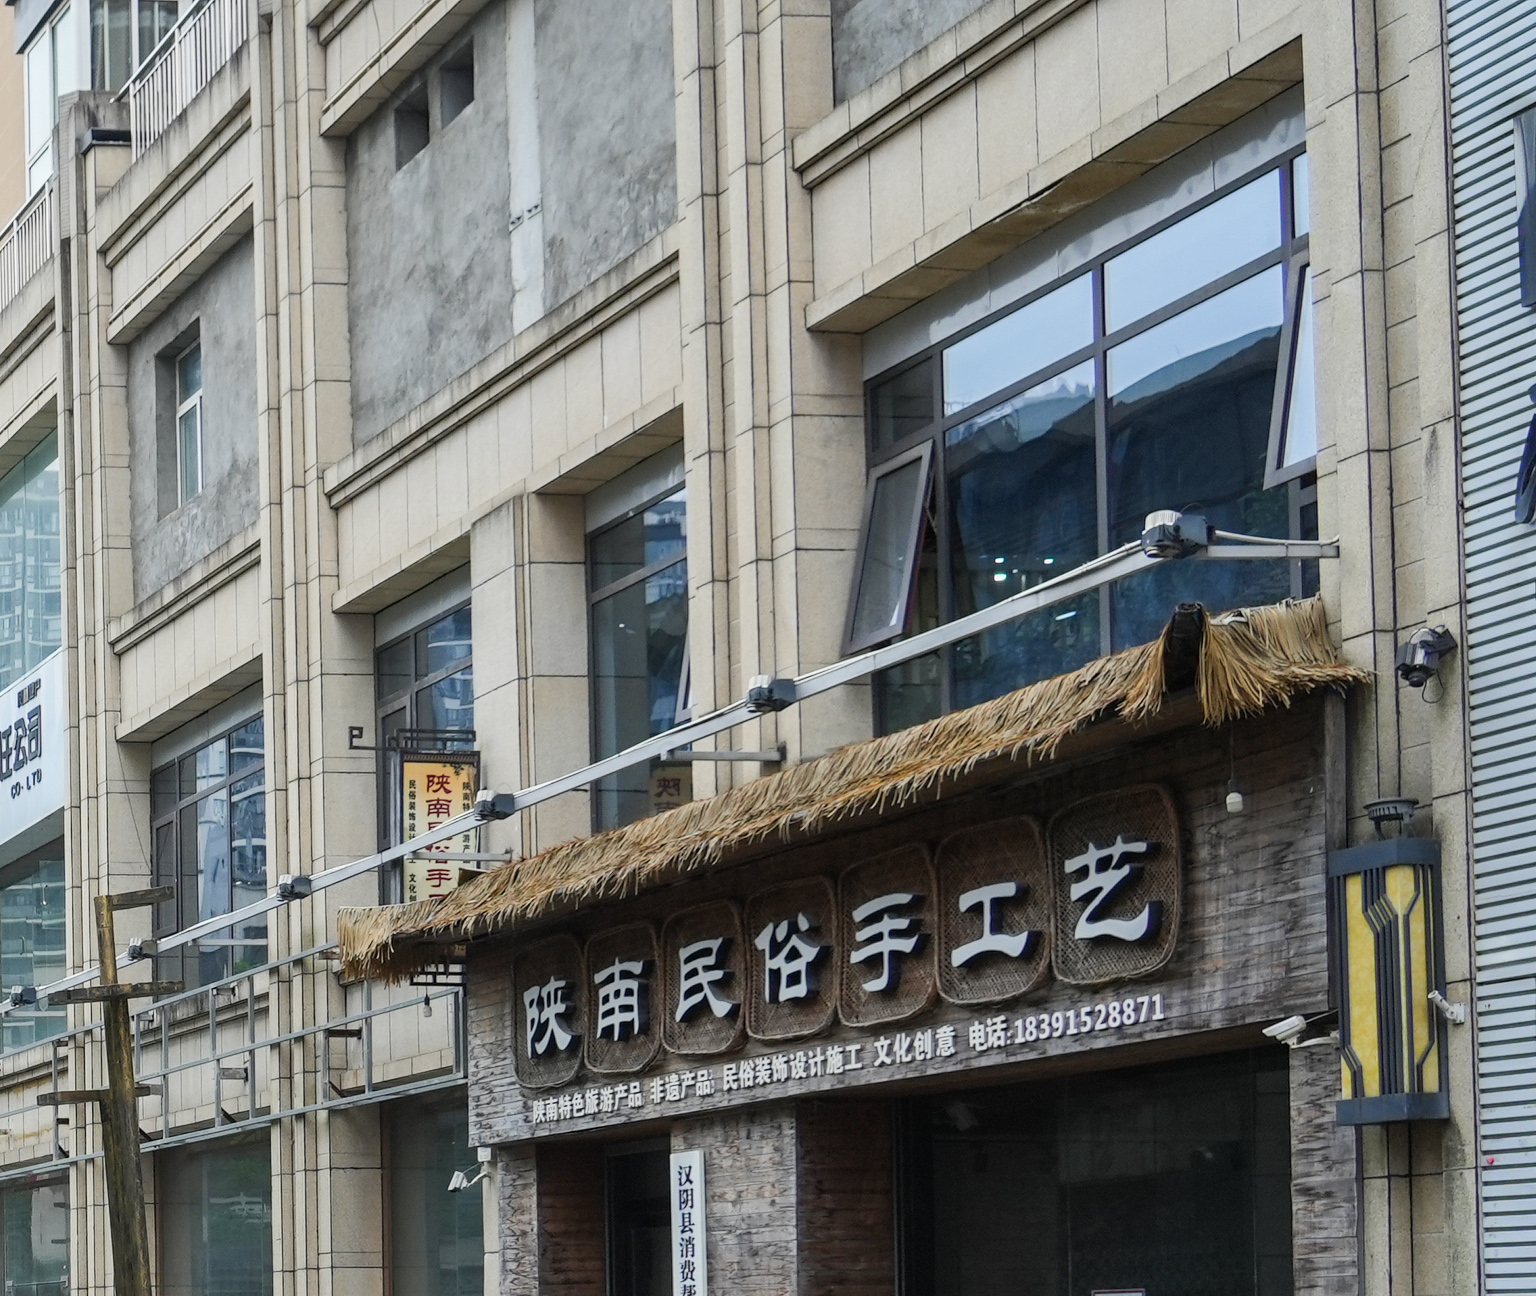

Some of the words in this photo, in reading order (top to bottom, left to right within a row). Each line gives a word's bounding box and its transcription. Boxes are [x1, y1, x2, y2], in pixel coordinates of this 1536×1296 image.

[425, 774, 453, 901] 陕南俗手
[525, 834, 1150, 1058] 陕南民俗手工艺
[873, 1024, 956, 1067] 文化创意
